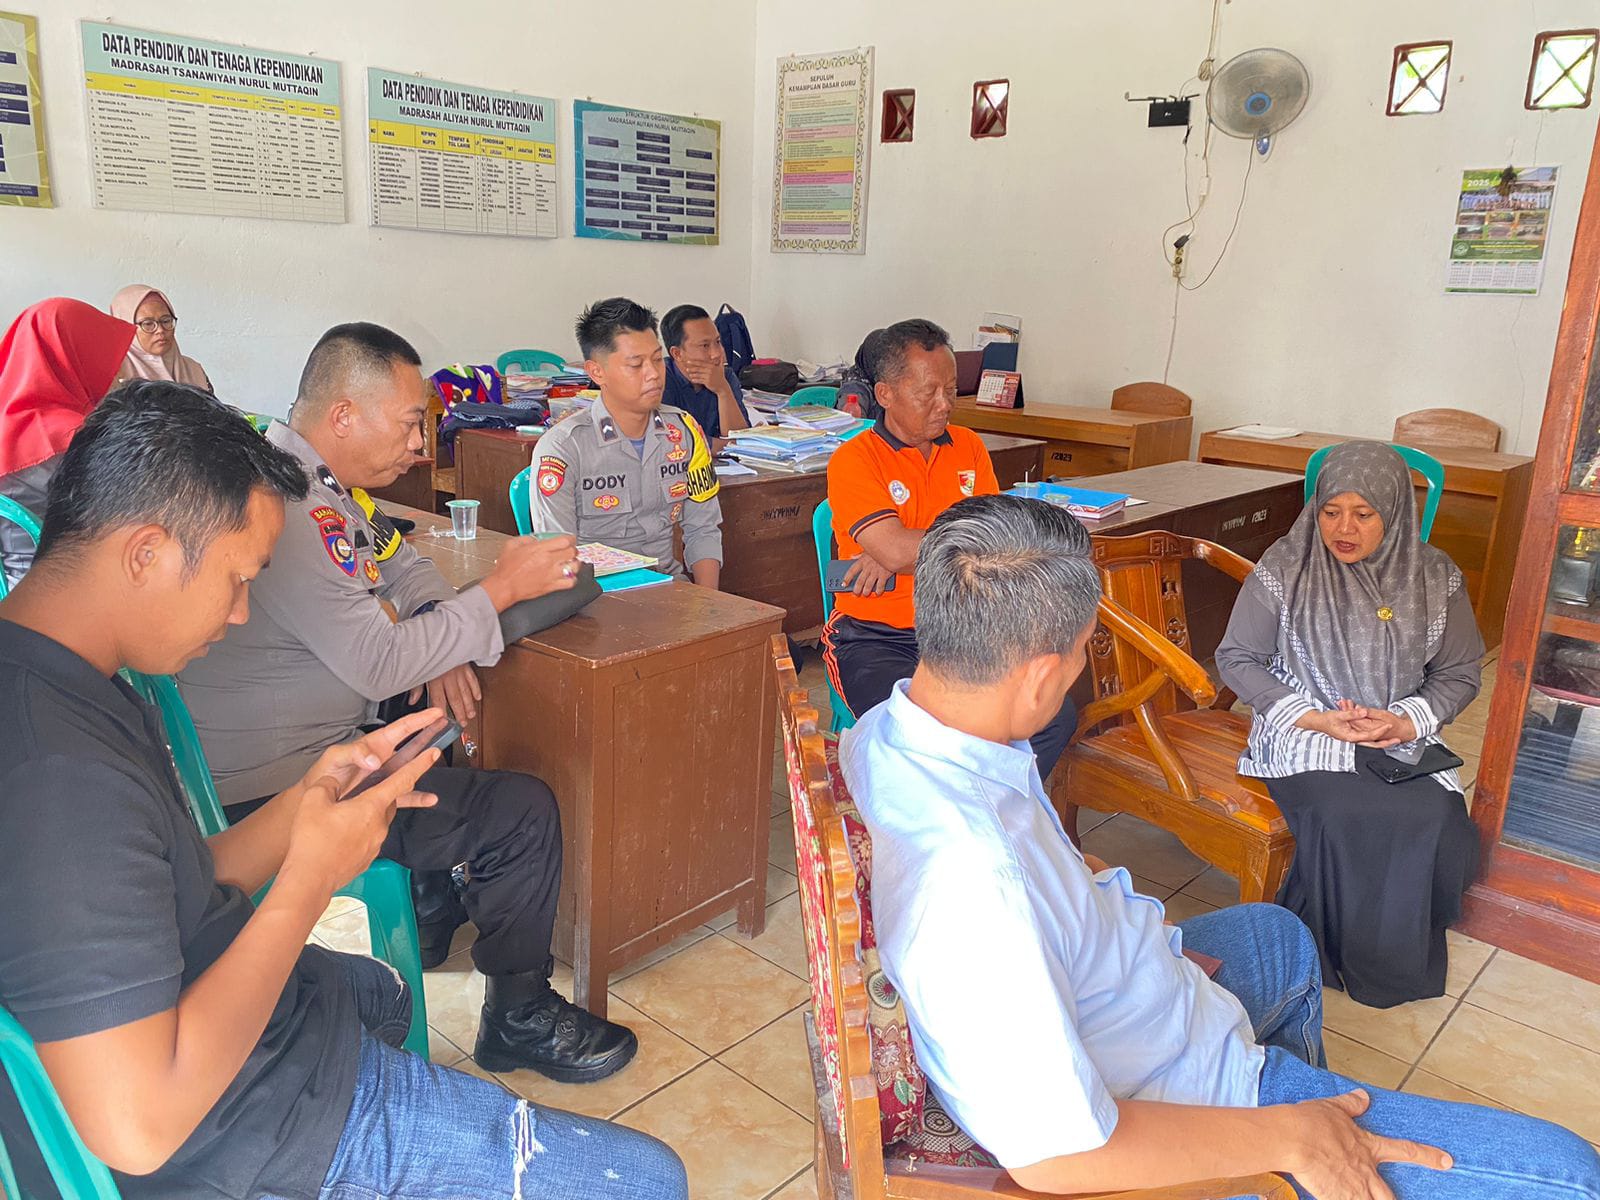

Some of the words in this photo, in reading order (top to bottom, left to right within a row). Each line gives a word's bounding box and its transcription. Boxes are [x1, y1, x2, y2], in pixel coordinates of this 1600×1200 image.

[102, 33, 131, 55] DATA
[134, 38, 185, 63] PENDIDIK
[188, 46, 209, 67] DAN
[211, 50, 252, 74] TENAGA
[254, 57, 323, 84] KEPENDIDIKAN
[111, 58, 170, 75] MADRASAH
[172, 67, 236, 85] TSANAWIYAH
[239, 77, 271, 90] NURUL
[272, 81, 319, 96] MUTTAQIN
[382, 79, 404, 100] DATA
[404, 83, 442, 107] PENDIDIK
[443, 89, 459, 110] DAN
[460, 92, 491, 114] TENAGA
[492, 97, 544, 122] KEPENDIDIKAN
[399, 106, 441, 120] MADRASAH
[442, 112, 469, 125] ALIYAH
[470, 116, 494, 128] NURUL
[495, 120, 531, 133] MUTTAQIN
[1467, 179, 1490, 187] 2025
[583, 474, 626, 491] DODY
[660, 462, 688, 478] POLR
